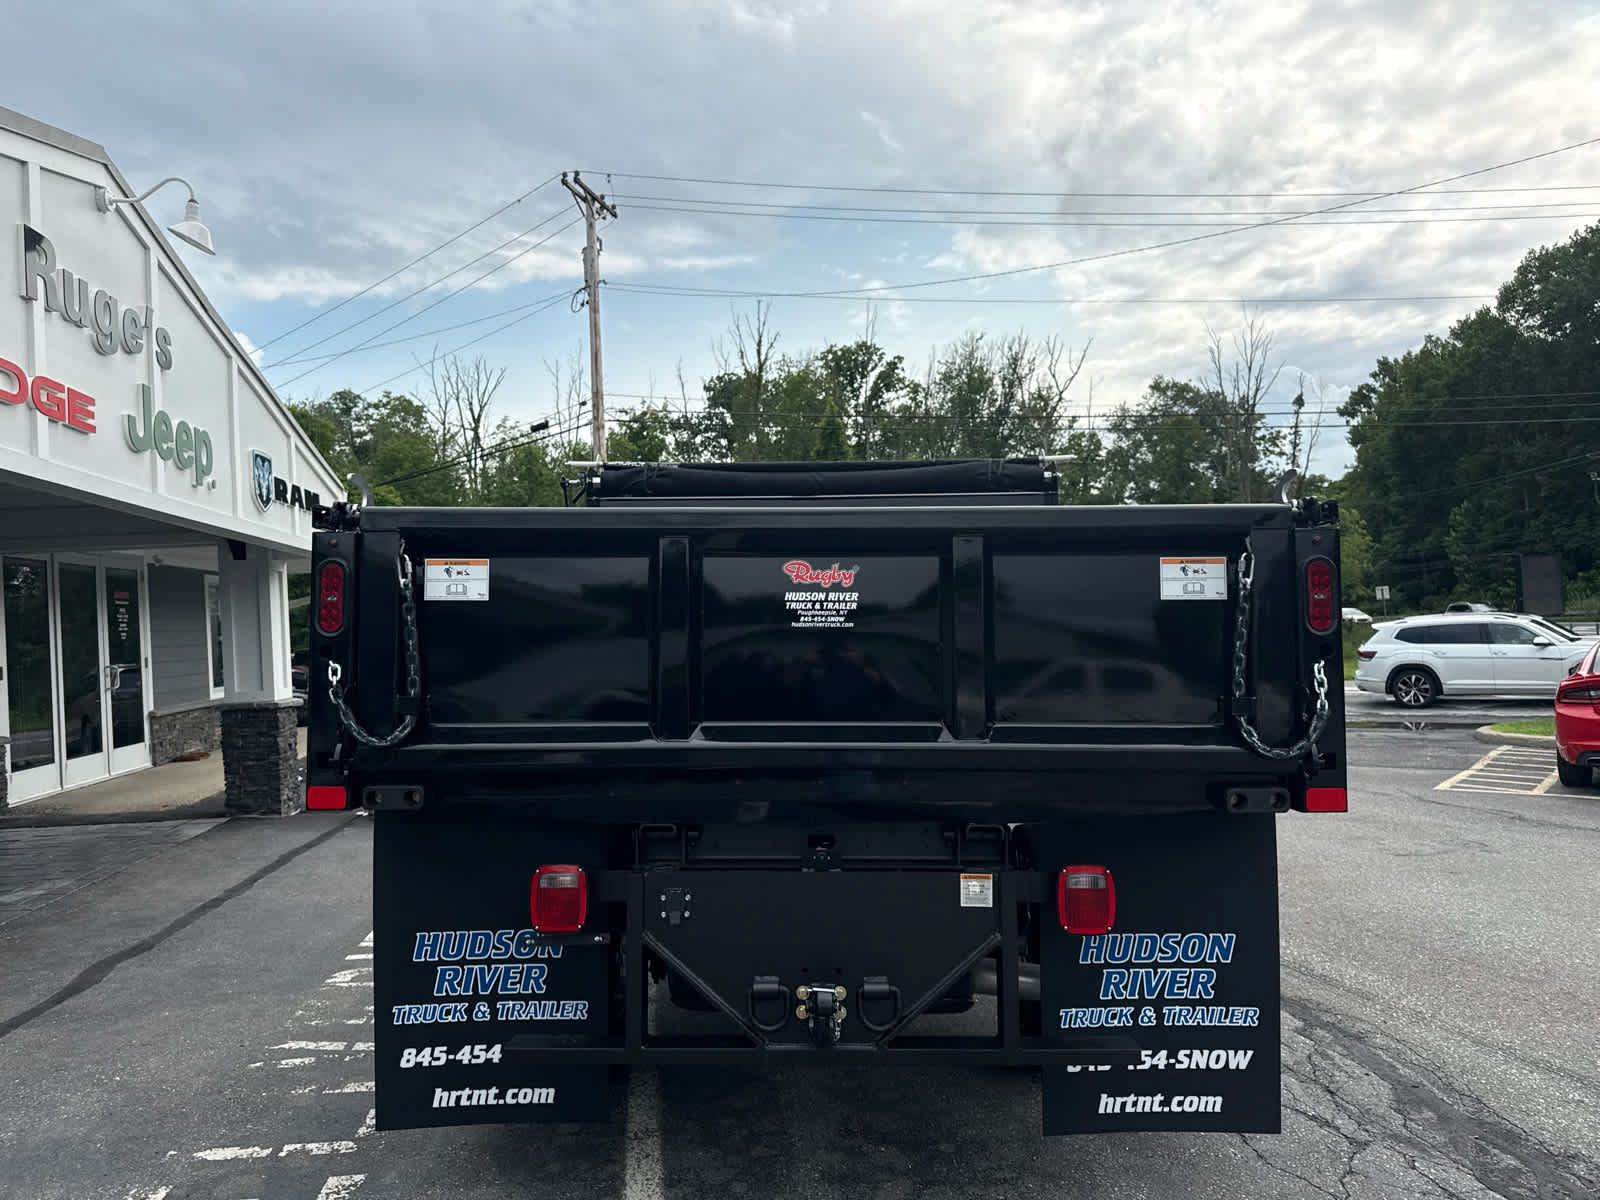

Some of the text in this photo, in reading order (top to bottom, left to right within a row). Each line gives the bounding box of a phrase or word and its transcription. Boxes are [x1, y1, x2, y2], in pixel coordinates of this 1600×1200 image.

[19, 224, 172, 369] Ruge's
[125, 383, 213, 487] Jeep
[274, 476, 320, 511] RAM
[783, 560, 856, 587] Rugby
[784, 592, 859, 601] HUDSON RIVER
[1079, 933, 1236, 964] HUDSON
[433, 964, 548, 996] RIVER
[1099, 968, 1217, 1000] RIVER
[392, 1001, 588, 1025] TRUCK & TRAILER
[1059, 1006, 1259, 1028] TRUCK & TRAILER
[1066, 1050, 1254, 1073] 54-SNOW
[432, 1086, 556, 1108] hrtnt.com
[1098, 1093, 1223, 1114] hrtnt.com
